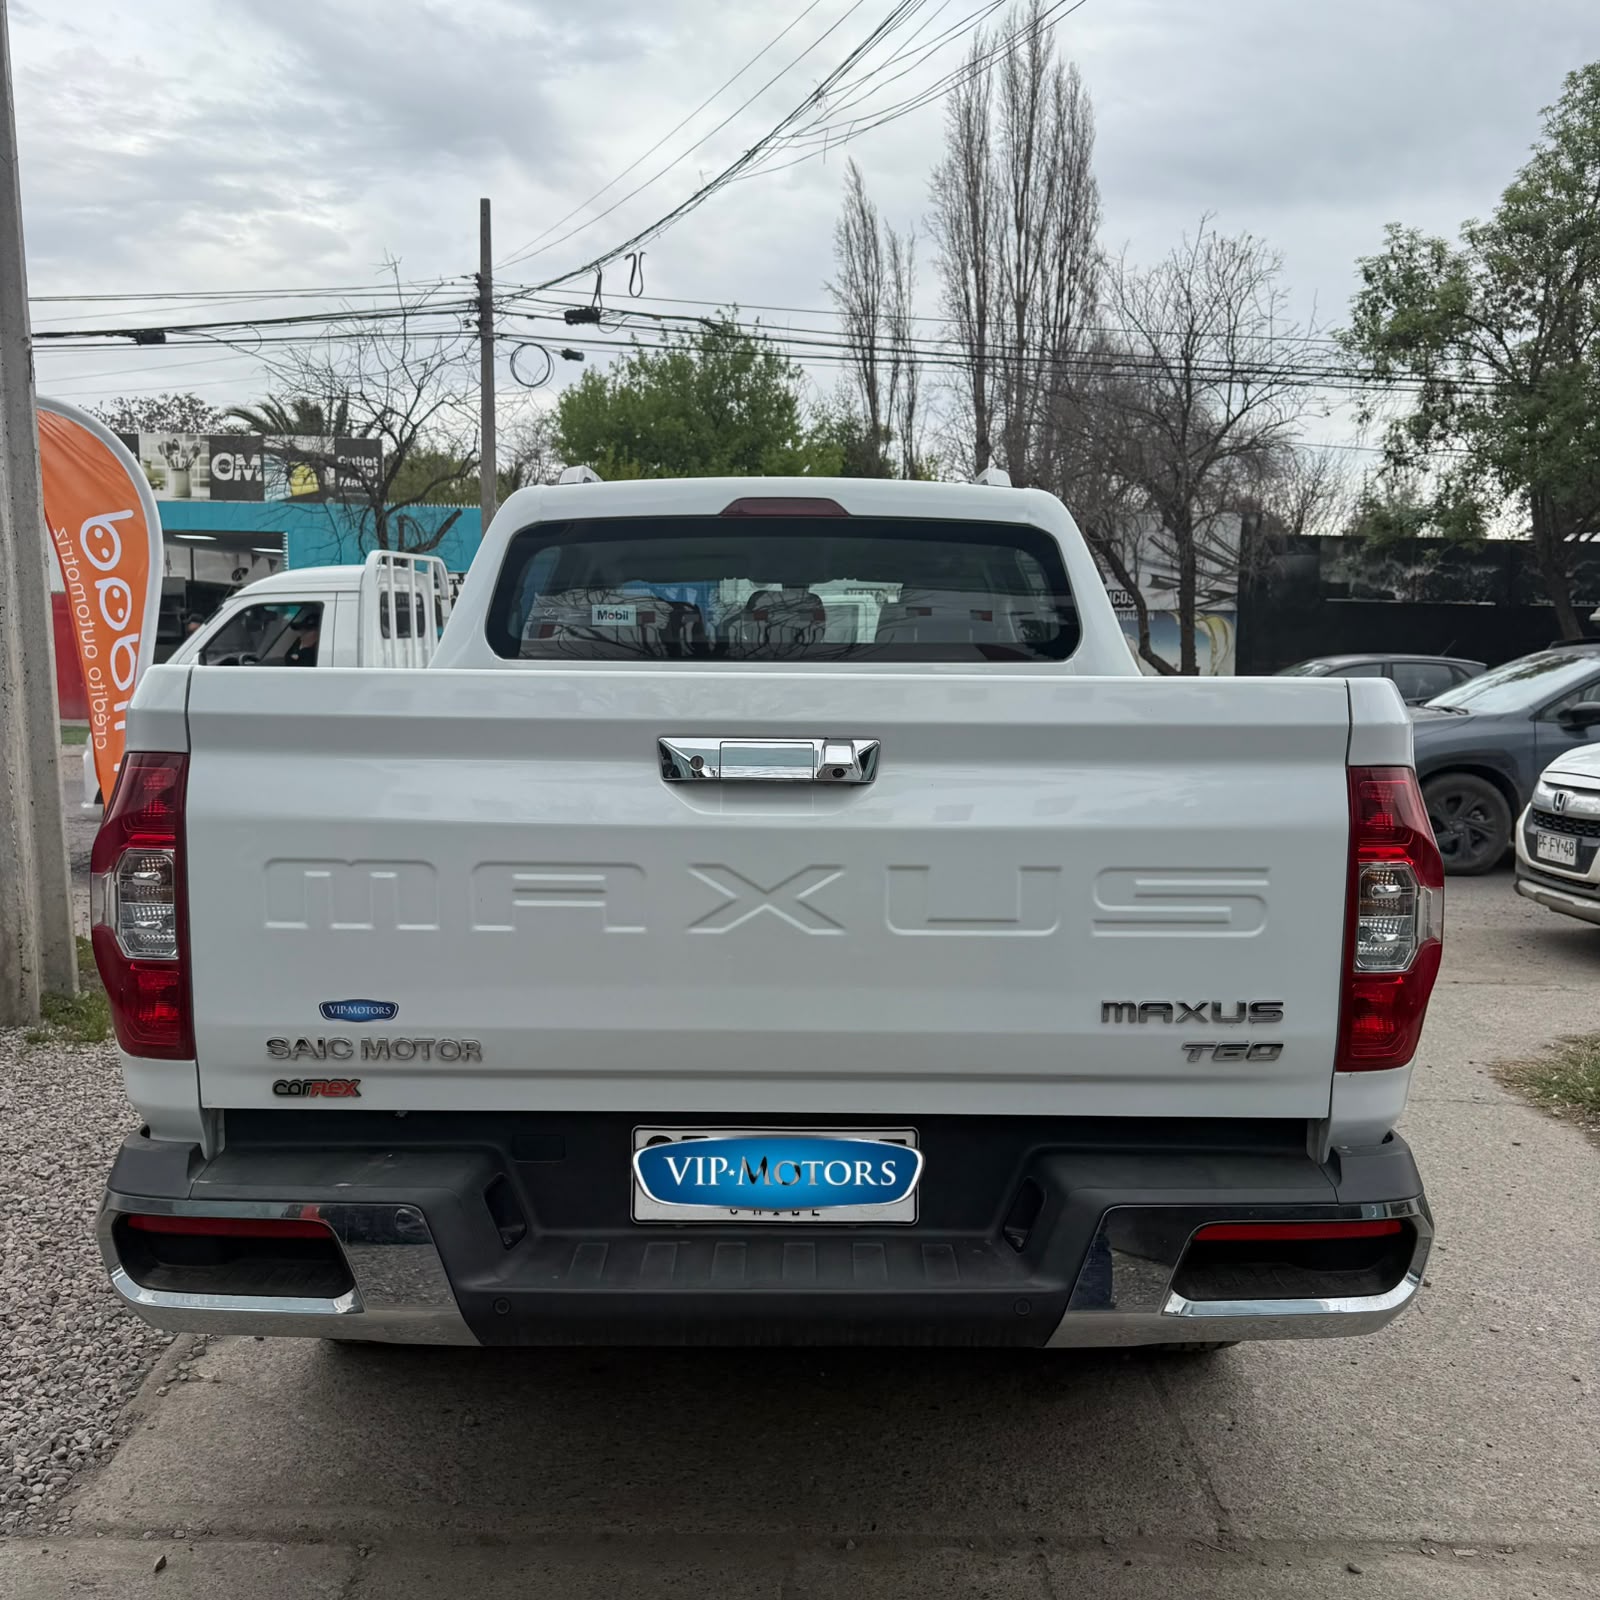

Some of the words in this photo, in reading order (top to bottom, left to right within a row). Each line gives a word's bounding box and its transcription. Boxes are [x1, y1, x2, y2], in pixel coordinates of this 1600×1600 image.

[597, 609, 629, 621] Mobil
[263, 858, 1271, 938] MAXUS
[1101, 1000, 1284, 1024] MAXUS
[266, 1036, 354, 1061] SAIC
[360, 1037, 483, 1062] MOTOR
[1182, 1041, 1284, 1063] T60
